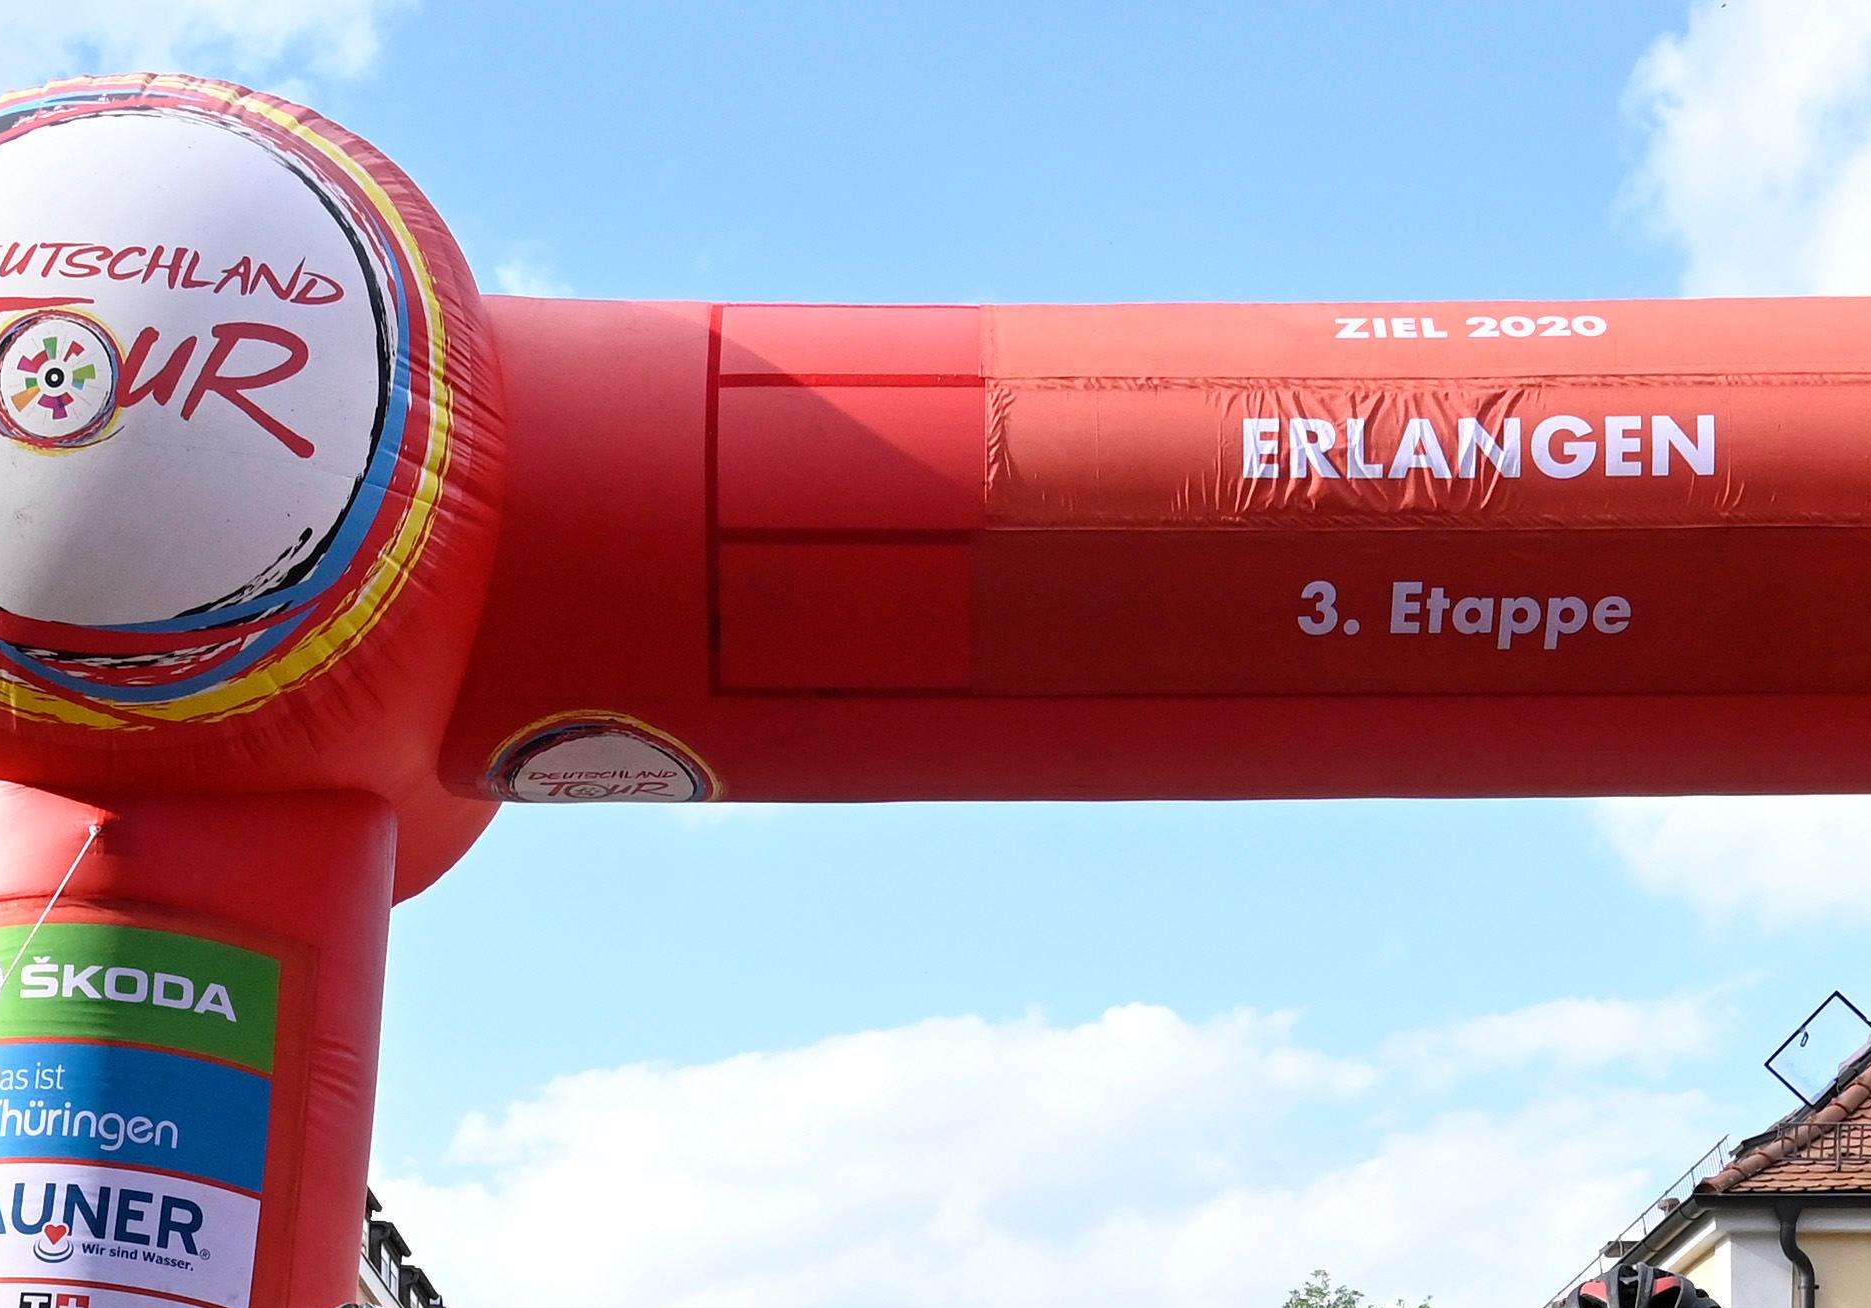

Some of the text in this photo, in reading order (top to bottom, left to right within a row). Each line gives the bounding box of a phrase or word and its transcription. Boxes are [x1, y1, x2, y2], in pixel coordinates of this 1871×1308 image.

[1335, 315, 1607, 339] ZIEL 2020
[1242, 415, 1715, 480] ERLANGEN
[1298, 581, 1631, 650] 3. Etappe
[529, 769, 677, 780] DEUTSCHLAND
[540, 782, 674, 798] TOUR
[20, 956, 237, 1022] ŠKODA
[34, 1062, 65, 1089] ist
[81, 1243, 194, 1271] Wir sind Wasser.
